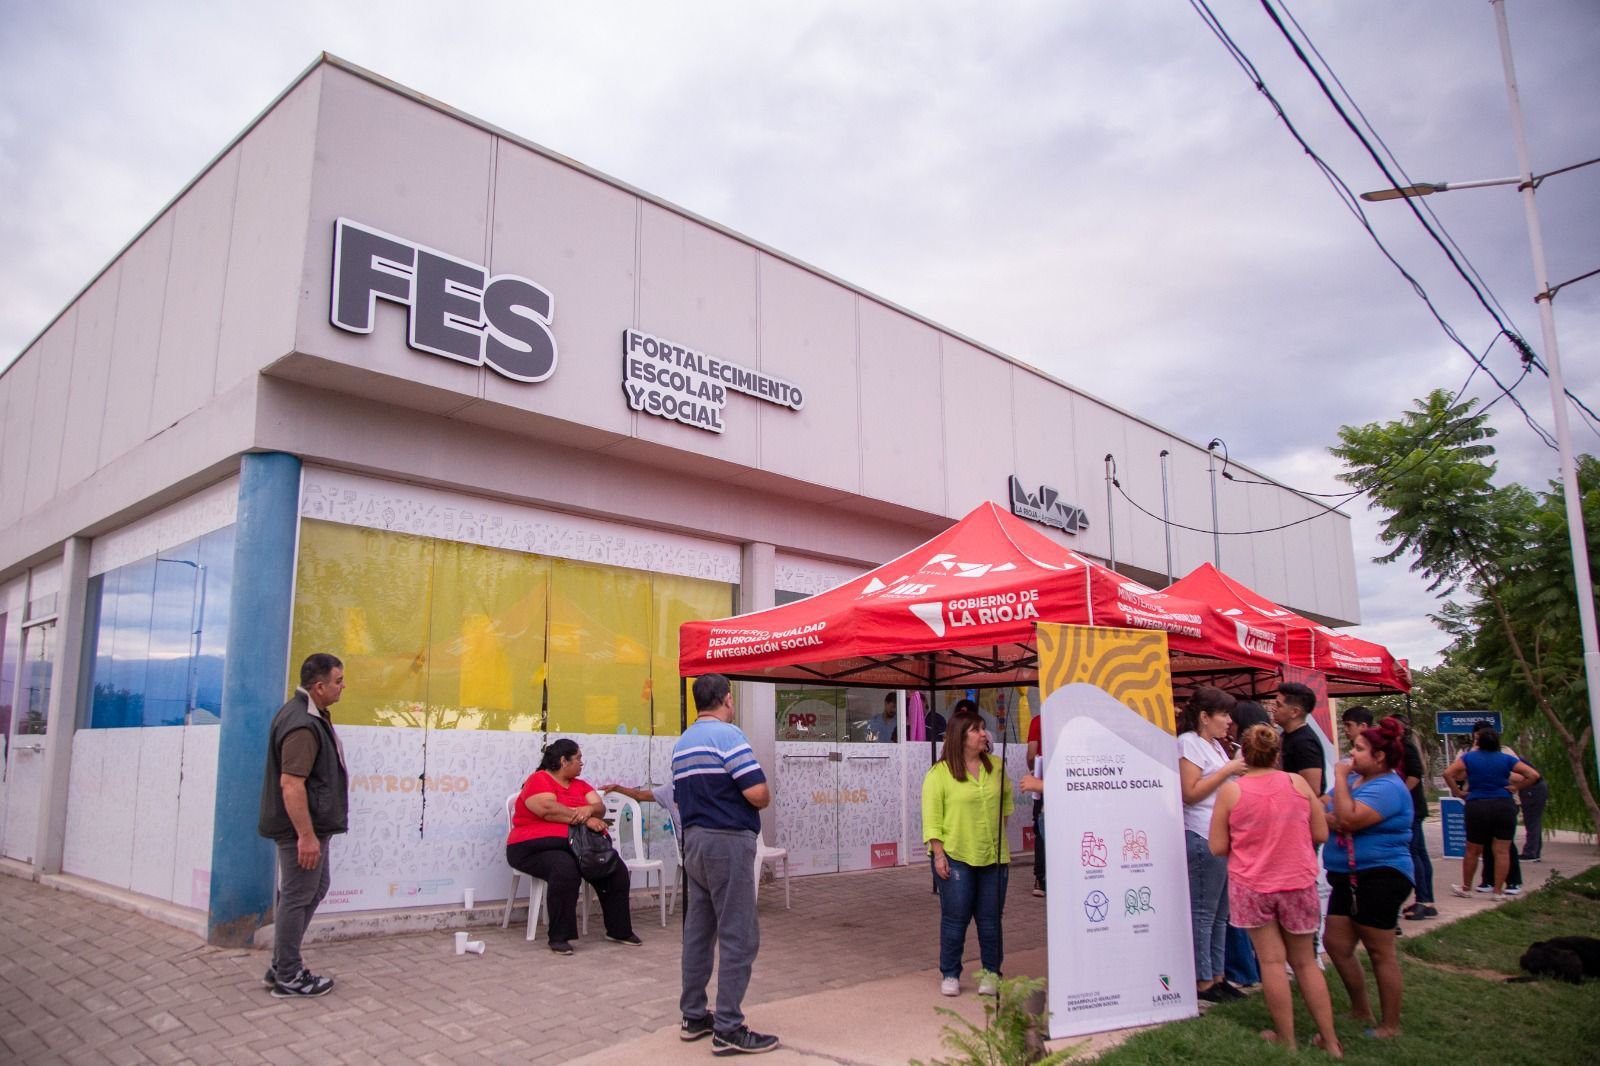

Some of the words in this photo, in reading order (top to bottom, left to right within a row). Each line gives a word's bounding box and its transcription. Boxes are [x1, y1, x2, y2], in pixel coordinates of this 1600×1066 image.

[335, 221, 556, 380] FES
[630, 333, 803, 406] FORTALECIMIENTO
[630, 358, 724, 404] ESCOLAR
[630, 384, 646, 406] Y
[648, 390, 722, 429] SOCIAL
[948, 592, 1017, 611] GOBIERNO
[1020, 589, 1039, 602] DE
[948, 610, 976, 627] LA
[978, 602, 1040, 625] RIOJA
[771, 621, 827, 639] IGUALDAD
[706, 649, 713, 659] E
[713, 641, 780, 659] INTEGRACIÓN
[781, 634, 824, 650] SOCIAL
[1066, 765, 1116, 778] INCLUSIÓN
[1118, 766, 1124, 776] Y
[1066, 780, 1128, 792] DESARROLLO
[1129, 778, 1164, 789] SOCIAL
